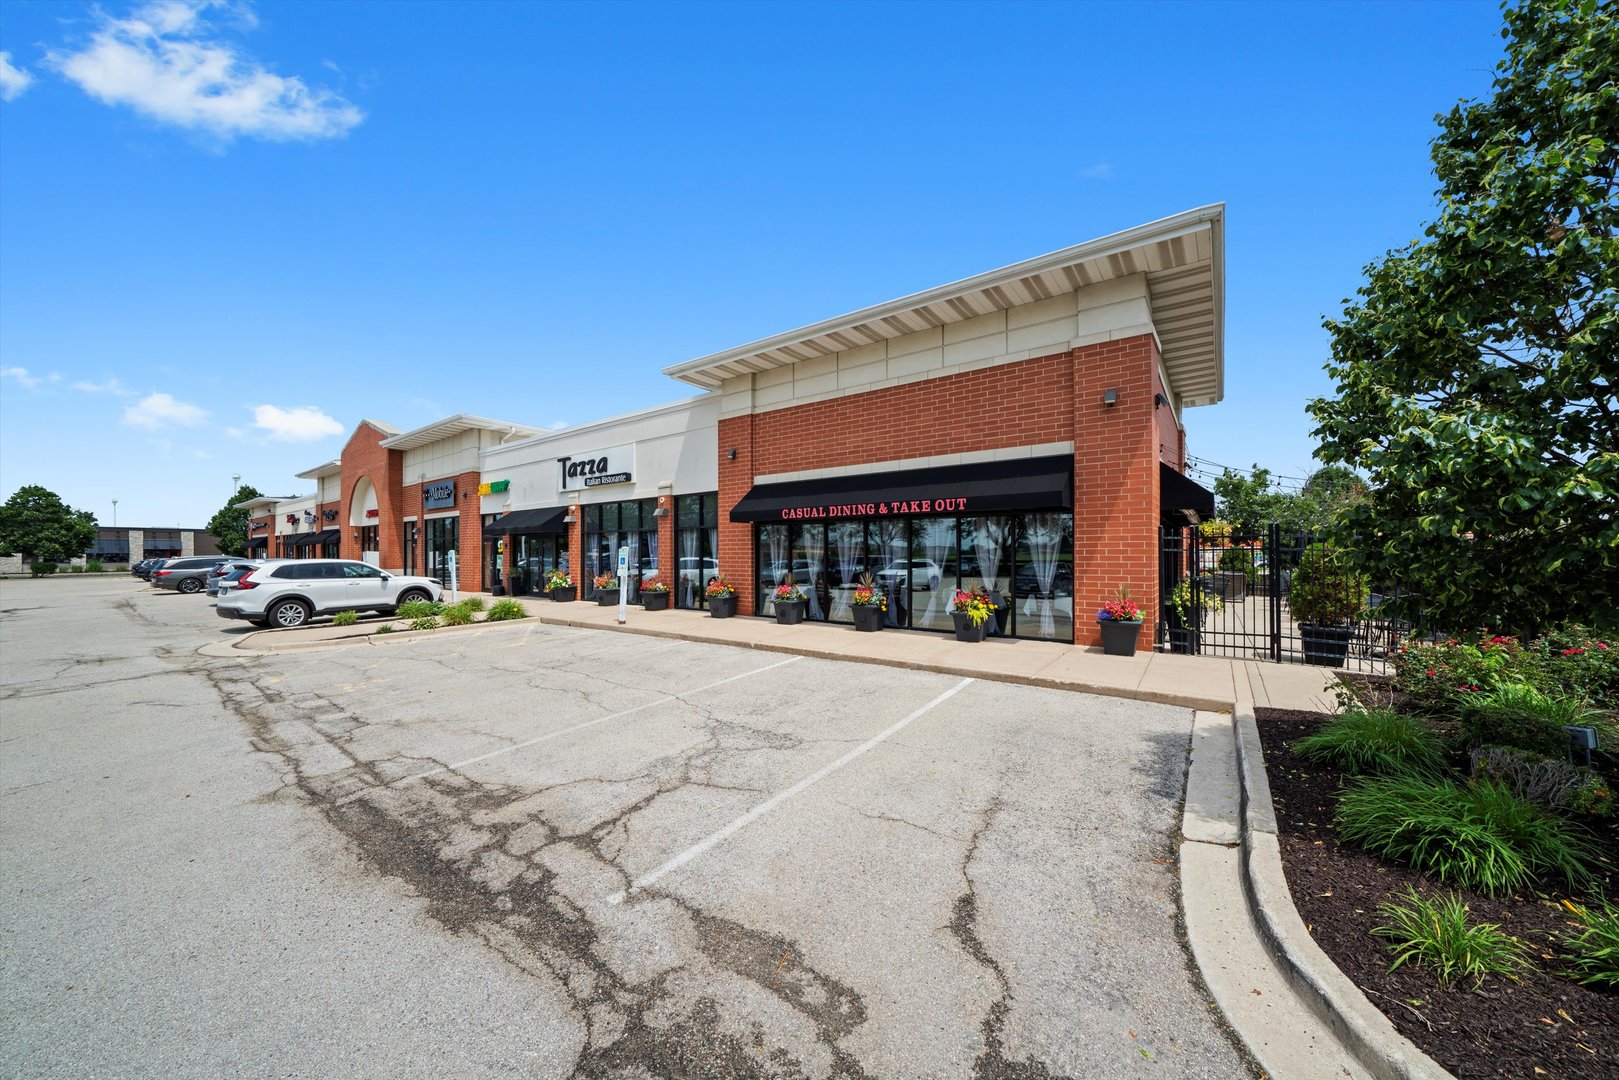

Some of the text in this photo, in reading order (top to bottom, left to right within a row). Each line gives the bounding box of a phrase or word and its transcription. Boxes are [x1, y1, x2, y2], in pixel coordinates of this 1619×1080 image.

[557, 456, 608, 489] Tazza
[586, 474, 627, 486] Italian Ristorante
[782, 498, 967, 519] CASUAL DINING & TAKE OUT
